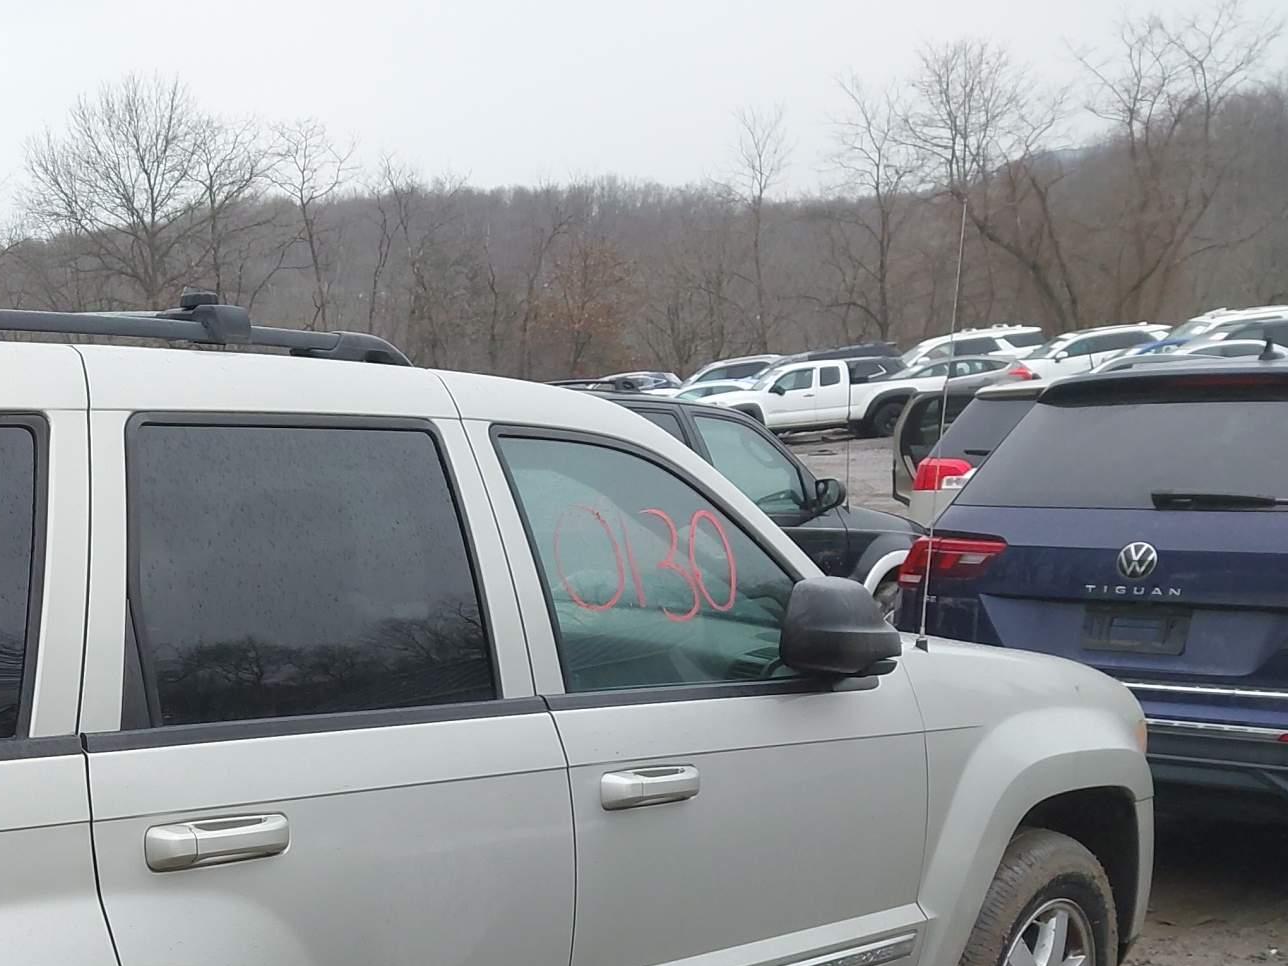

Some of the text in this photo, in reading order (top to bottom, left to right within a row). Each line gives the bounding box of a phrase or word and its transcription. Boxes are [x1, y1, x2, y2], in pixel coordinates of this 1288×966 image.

[554, 502, 736, 622] 0130
[1116, 541, 1158, 581] VW
[1084, 584, 1183, 597] TIGUAN
